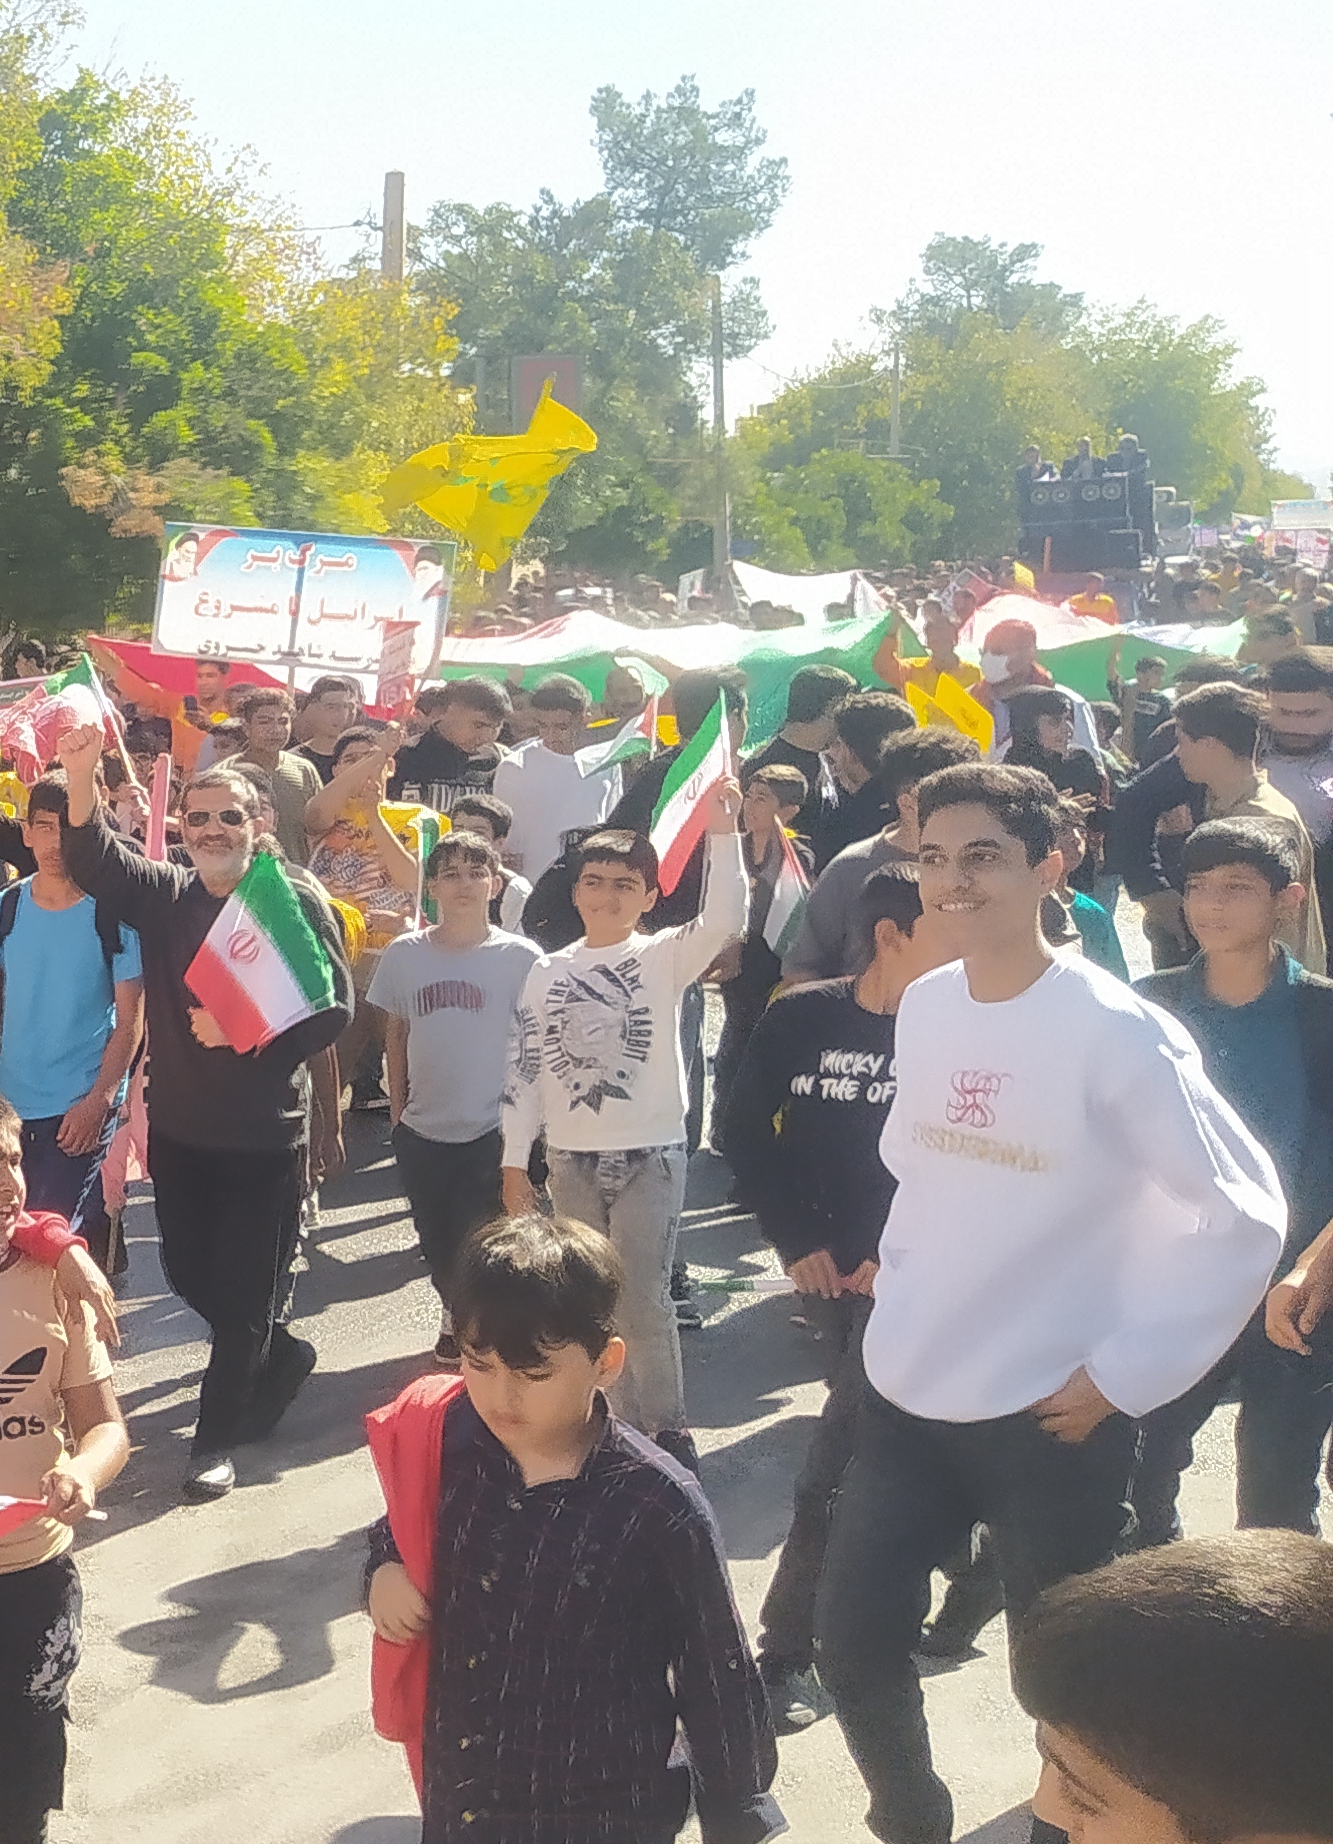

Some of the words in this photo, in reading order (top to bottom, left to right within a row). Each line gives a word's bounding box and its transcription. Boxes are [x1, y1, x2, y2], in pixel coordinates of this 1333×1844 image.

[244, 550, 280, 570] بر
[287, 543, 354, 574] مرگ
[546, 979, 570, 1004] THE
[820, 1050, 884, 1078] MICKY
[790, 1076, 815, 1096] IN
[820, 1078, 860, 1101] THE
